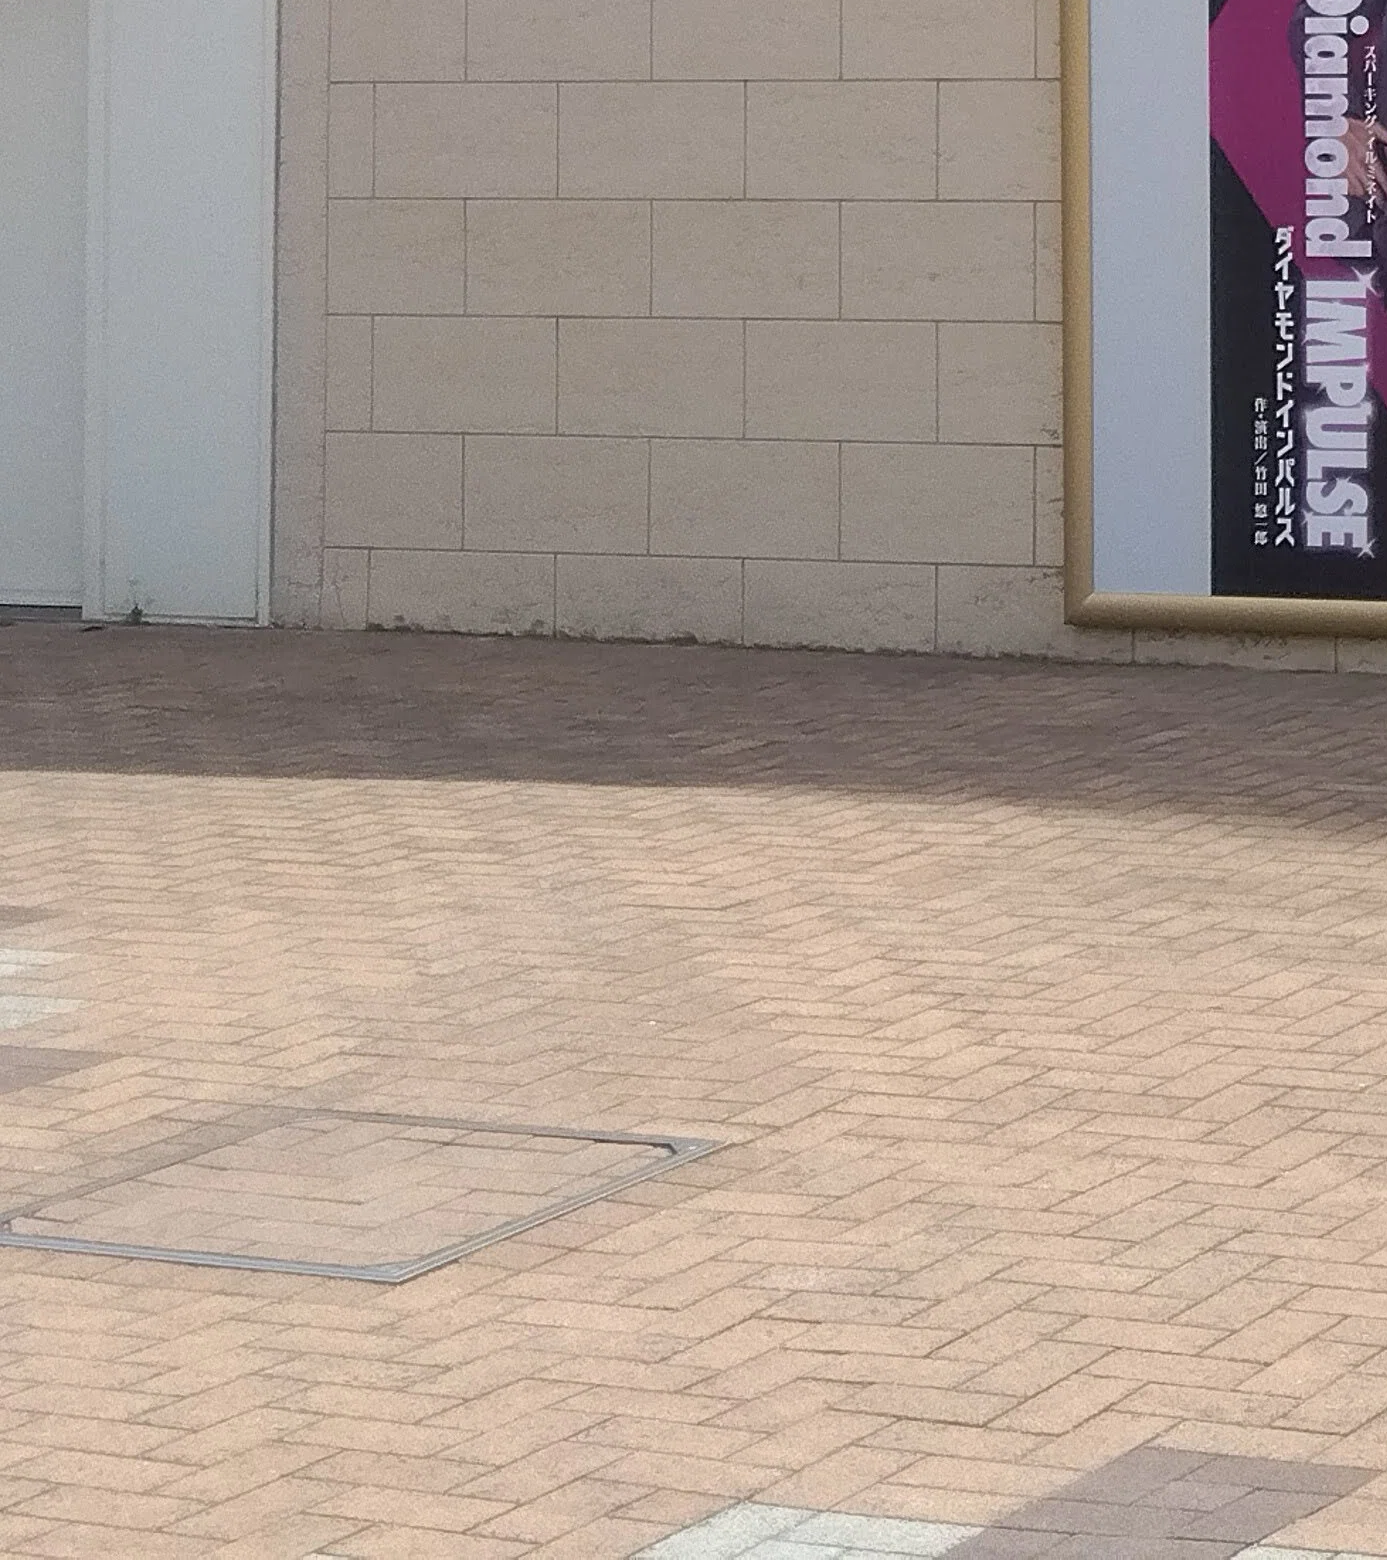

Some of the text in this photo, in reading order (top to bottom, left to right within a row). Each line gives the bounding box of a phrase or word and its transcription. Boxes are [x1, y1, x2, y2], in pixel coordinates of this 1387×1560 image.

[1273, 225, 1296, 547] ダイヤモンドインパルス
[1303, 276, 1374, 552] IMPULSE
